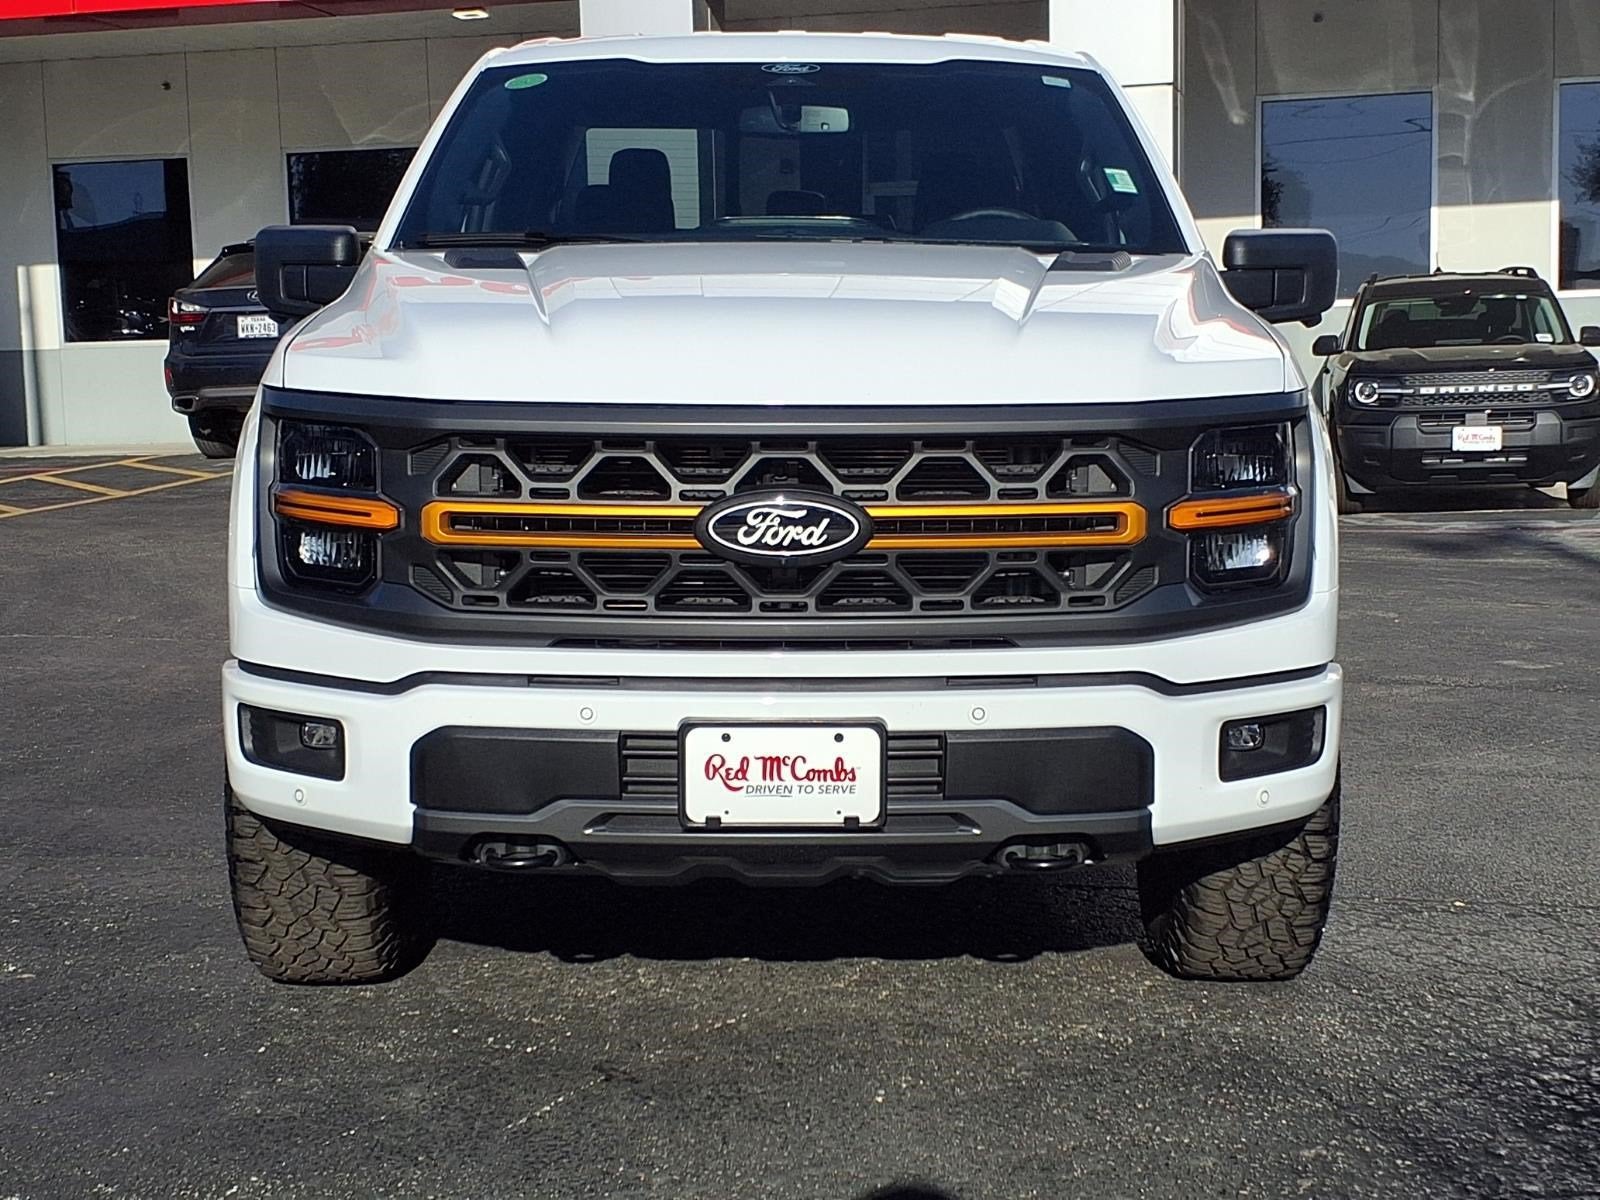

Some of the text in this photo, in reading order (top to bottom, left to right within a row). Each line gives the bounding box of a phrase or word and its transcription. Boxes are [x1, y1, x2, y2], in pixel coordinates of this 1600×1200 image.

[768, 63, 810, 72] Ford
[1419, 383, 1533, 395] BRONCO
[737, 507, 830, 546] Ford
[704, 753, 857, 792] Red McCombs
[746, 784, 857, 794] DRIVEN TO SERVE
